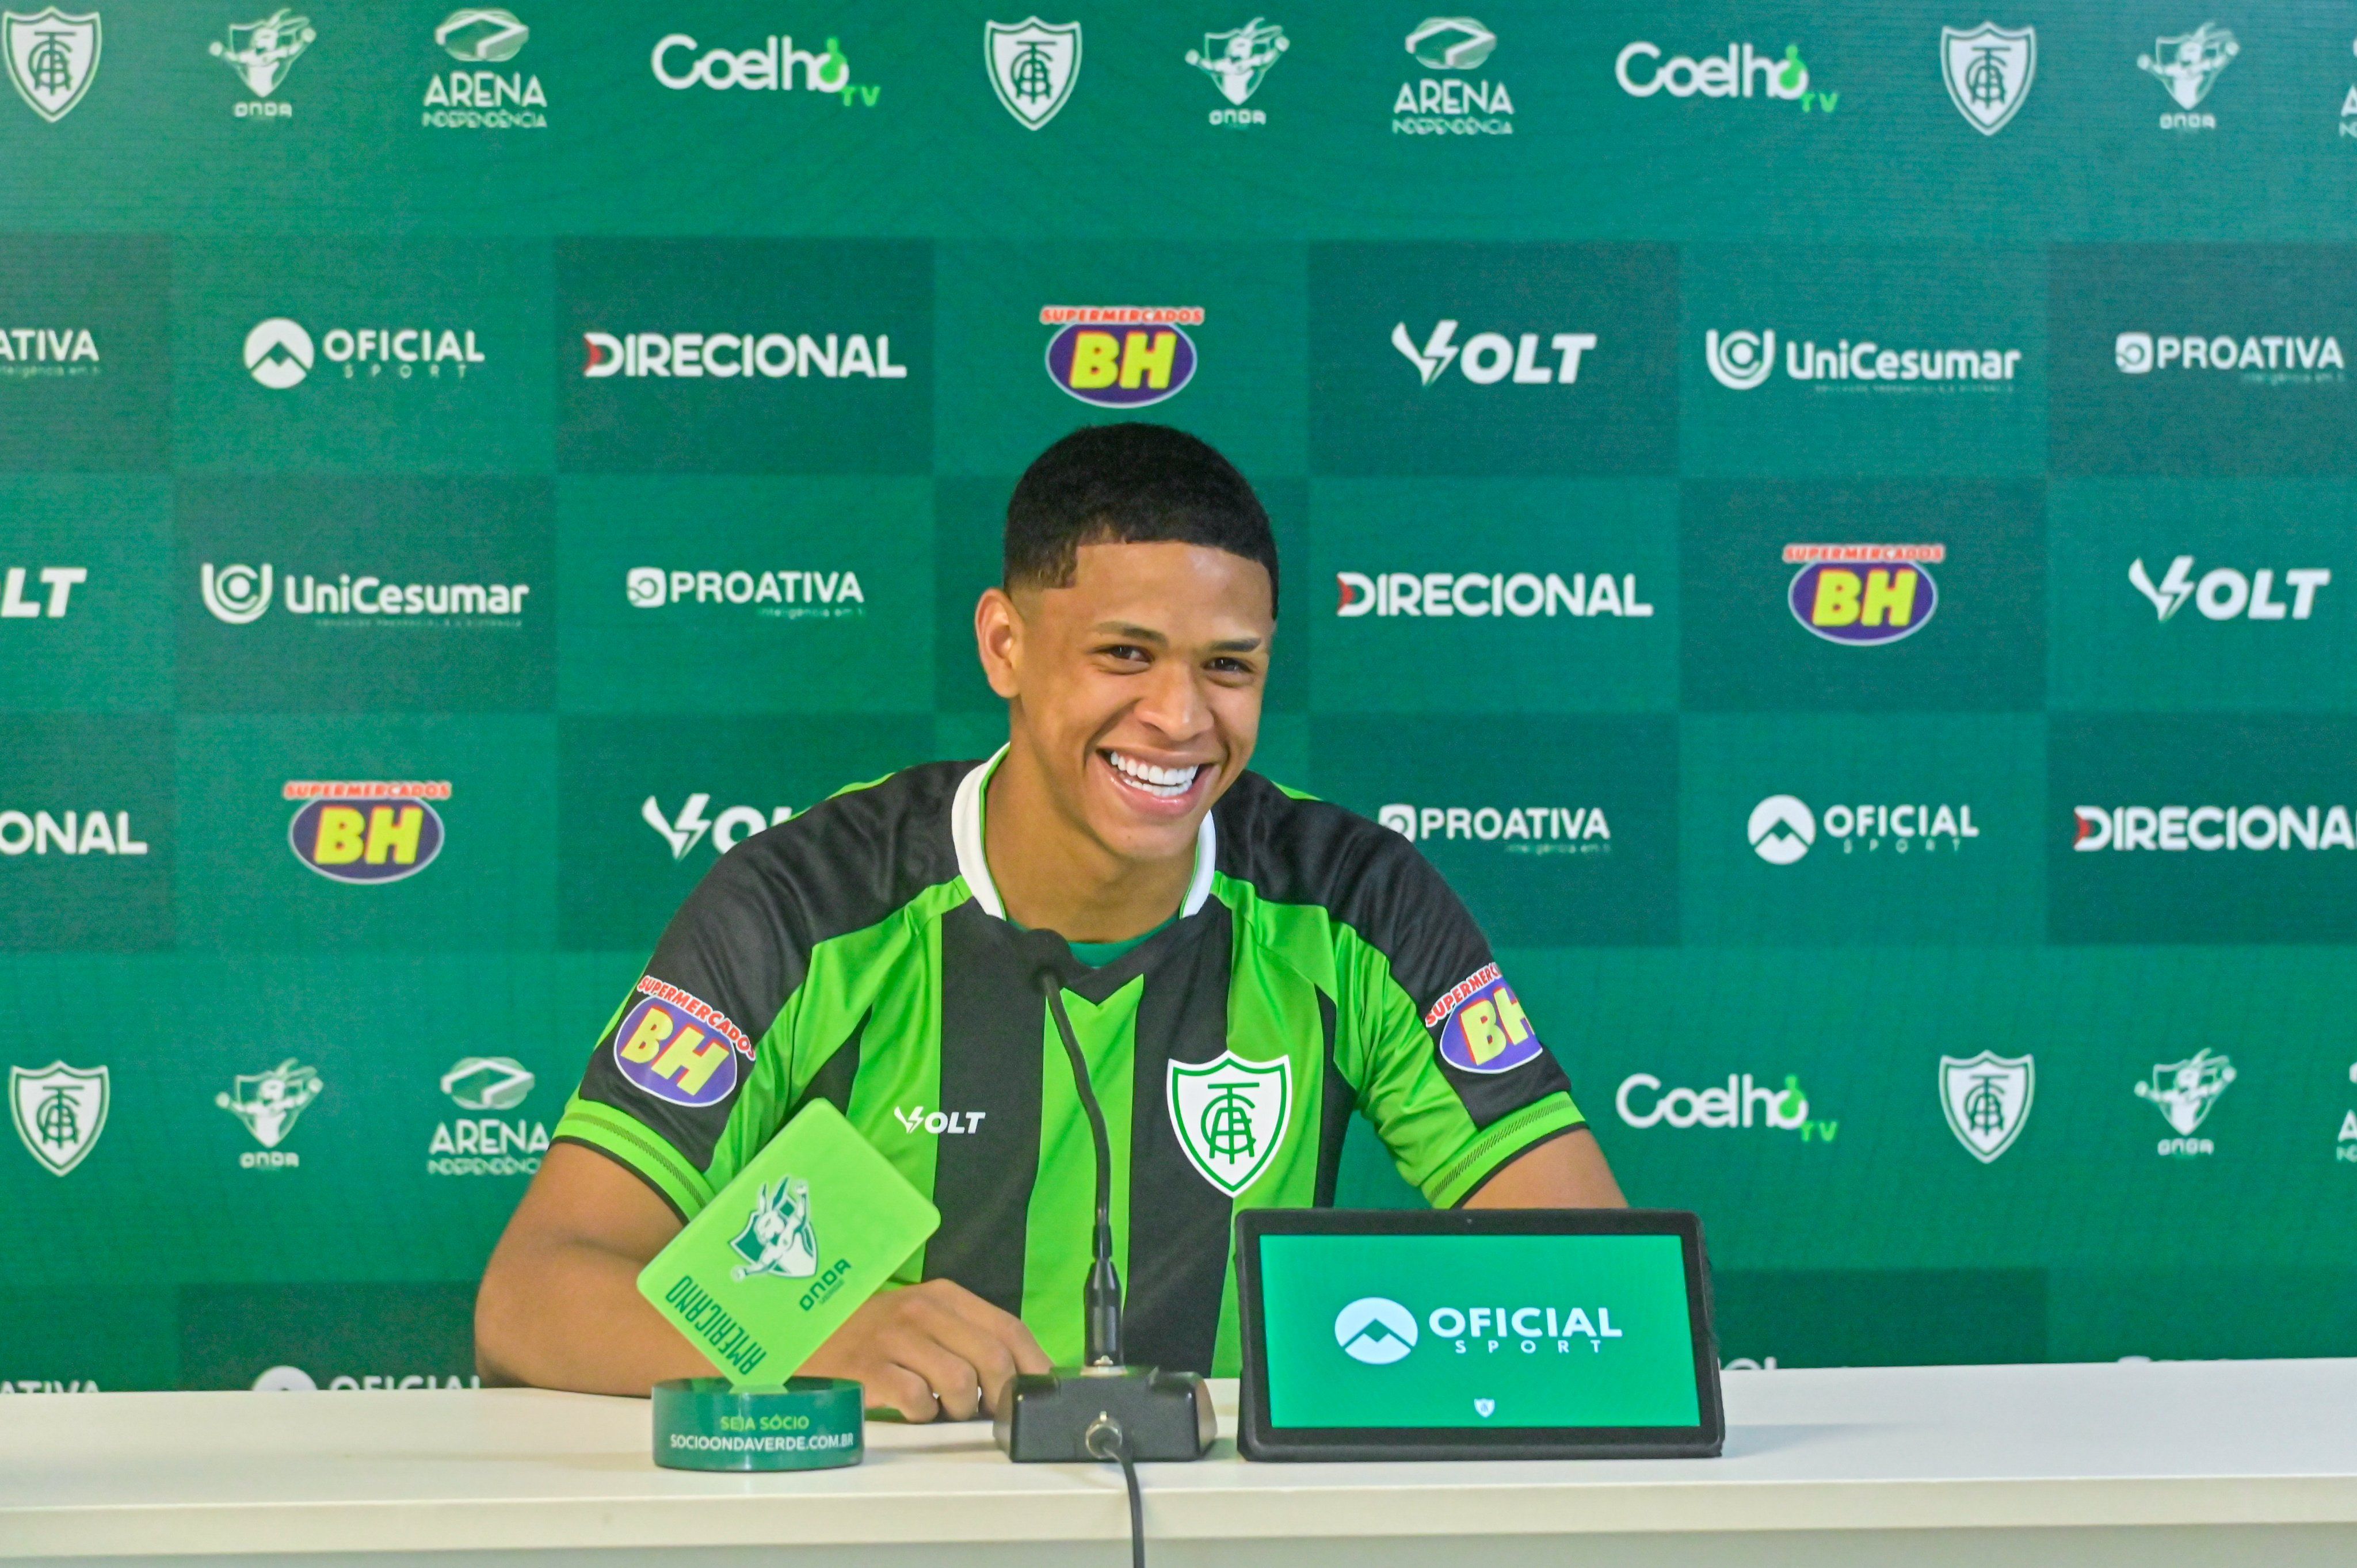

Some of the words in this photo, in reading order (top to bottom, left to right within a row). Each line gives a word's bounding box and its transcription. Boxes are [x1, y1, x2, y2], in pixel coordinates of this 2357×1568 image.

[651, 33, 850, 93] Coelho
[841, 85, 881, 107] TV
[1615, 40, 1809, 100] Coelho
[1800, 92, 1838, 113] TV
[424, 71, 547, 108] ARENA
[1394, 78, 1514, 115] ARENA
[1039, 305, 1206, 326] SUPERMERCADOS
[323, 329, 485, 362] OFICIAL
[583, 332, 907, 378] DIRECIONAL
[1068, 329, 1177, 389] BH
[1391, 319, 1597, 385] VOLT
[1786, 339, 2022, 380] UniCesumar
[2157, 336, 2344, 369] PROATIVA
[344, 363, 467, 379] SPORT
[1782, 543, 1945, 563] SUPERMERCADOS
[285, 574, 529, 614] UniCesumar
[670, 571, 864, 604] PROATIVA
[1337, 572, 1654, 617] DIRECIONAL
[1811, 567, 1919, 627] BH
[2129, 555, 2331, 620] VOLT
[283, 780, 452, 800] SUPERMERCADOS
[314, 804, 424, 864] BH
[1421, 807, 1610, 840] PROATIVA
[1824, 804, 1980, 838] OFICIAL
[2074, 806, 2357, 851] DIRECIONA
[1843, 837, 1961, 854] SPORT
[636, 975, 757, 1061] SUPERMERCADOS
[620, 1005, 730, 1096] BH
[893, 1106, 986, 1134] VOLT
[1615, 1072, 1809, 1130] Coelho
[1799, 1120, 1838, 1142] TV
[429, 1118, 550, 1154] ARENA
[799, 1258, 851, 1311] ONDA
[665, 1275, 766, 1375] AMERICANO
[1429, 1307, 1623, 1338] OFICIAL
[1455, 1340, 1601, 1355] SPORT
[670, 1433, 854, 1452] SOCIOONDAVERDE.COM.BR
[720, 1416, 756, 1432] SEJA
